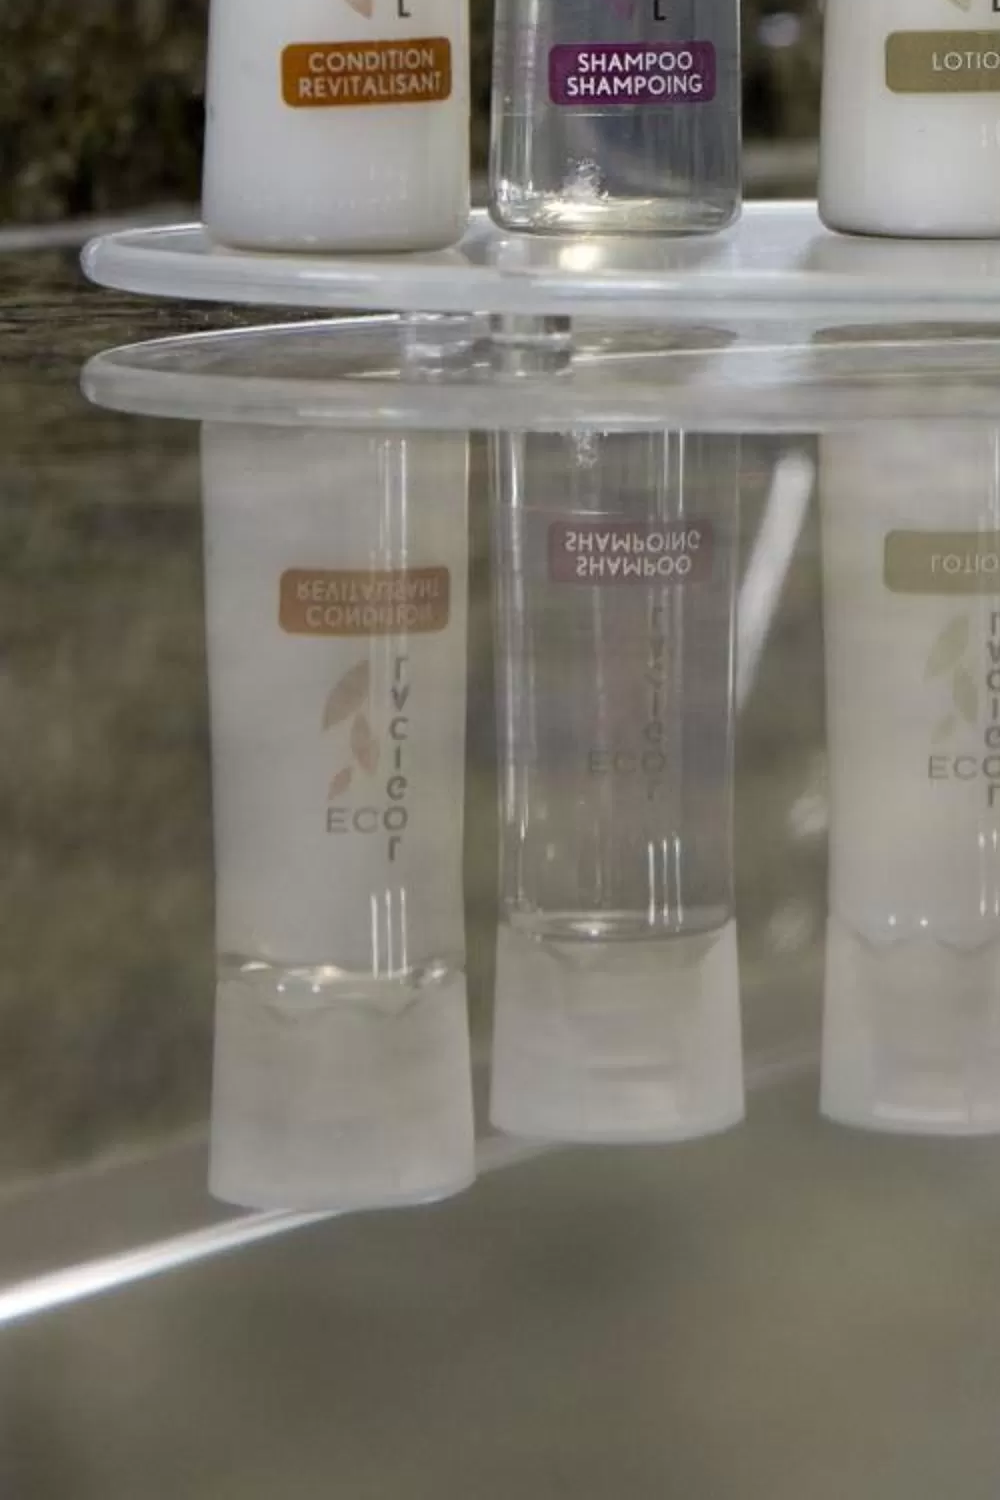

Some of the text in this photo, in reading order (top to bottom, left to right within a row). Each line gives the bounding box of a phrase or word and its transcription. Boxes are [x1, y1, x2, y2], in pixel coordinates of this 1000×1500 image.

[308, 48, 436, 71] CONDITION
[576, 51, 694, 73] SHAMPOO
[297, 70, 442, 97] REVITALISANT
[565, 73, 703, 96] SHAMPOING
